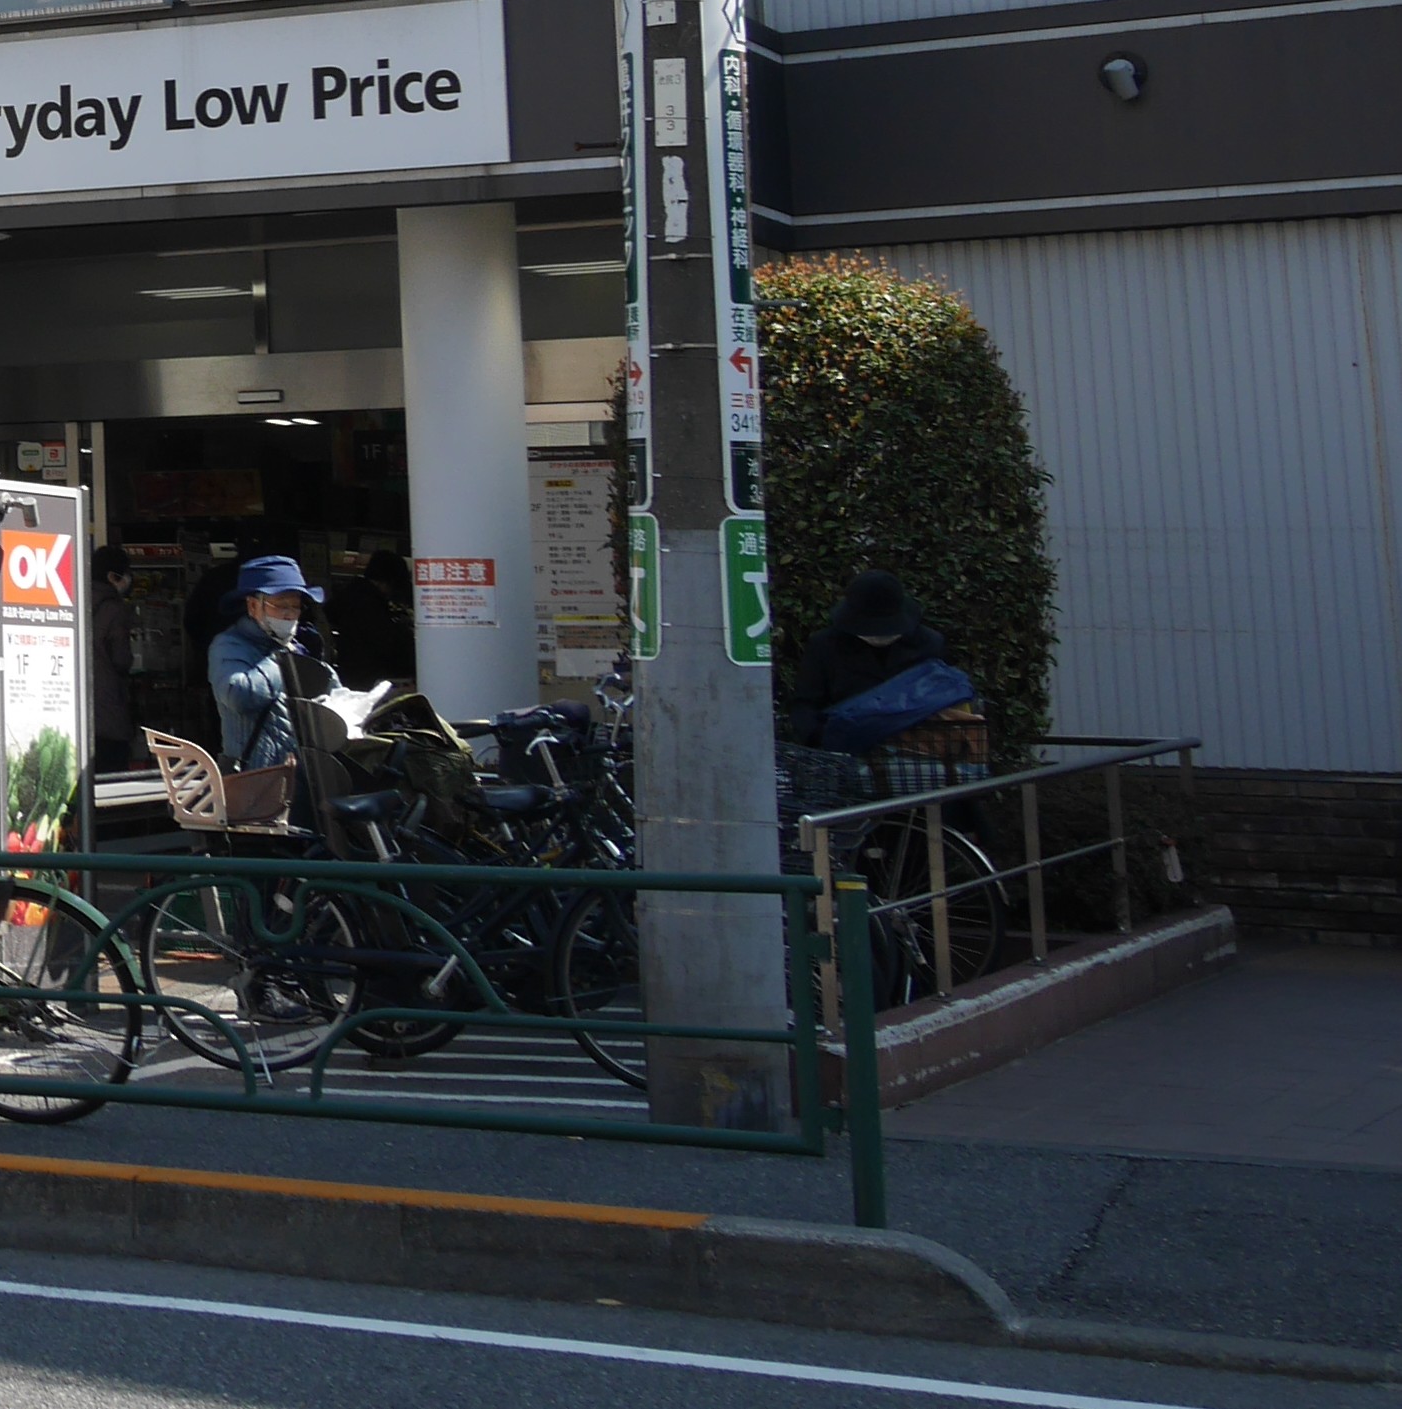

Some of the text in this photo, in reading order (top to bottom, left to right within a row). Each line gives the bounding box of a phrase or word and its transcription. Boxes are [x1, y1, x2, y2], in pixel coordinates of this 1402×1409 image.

[163, 78, 288, 131] Low
[311, 57, 462, 121] Price
[8, 534, 73, 606] OK
[16, 653, 29, 675] 1F
[50, 654, 64, 676] 2F
